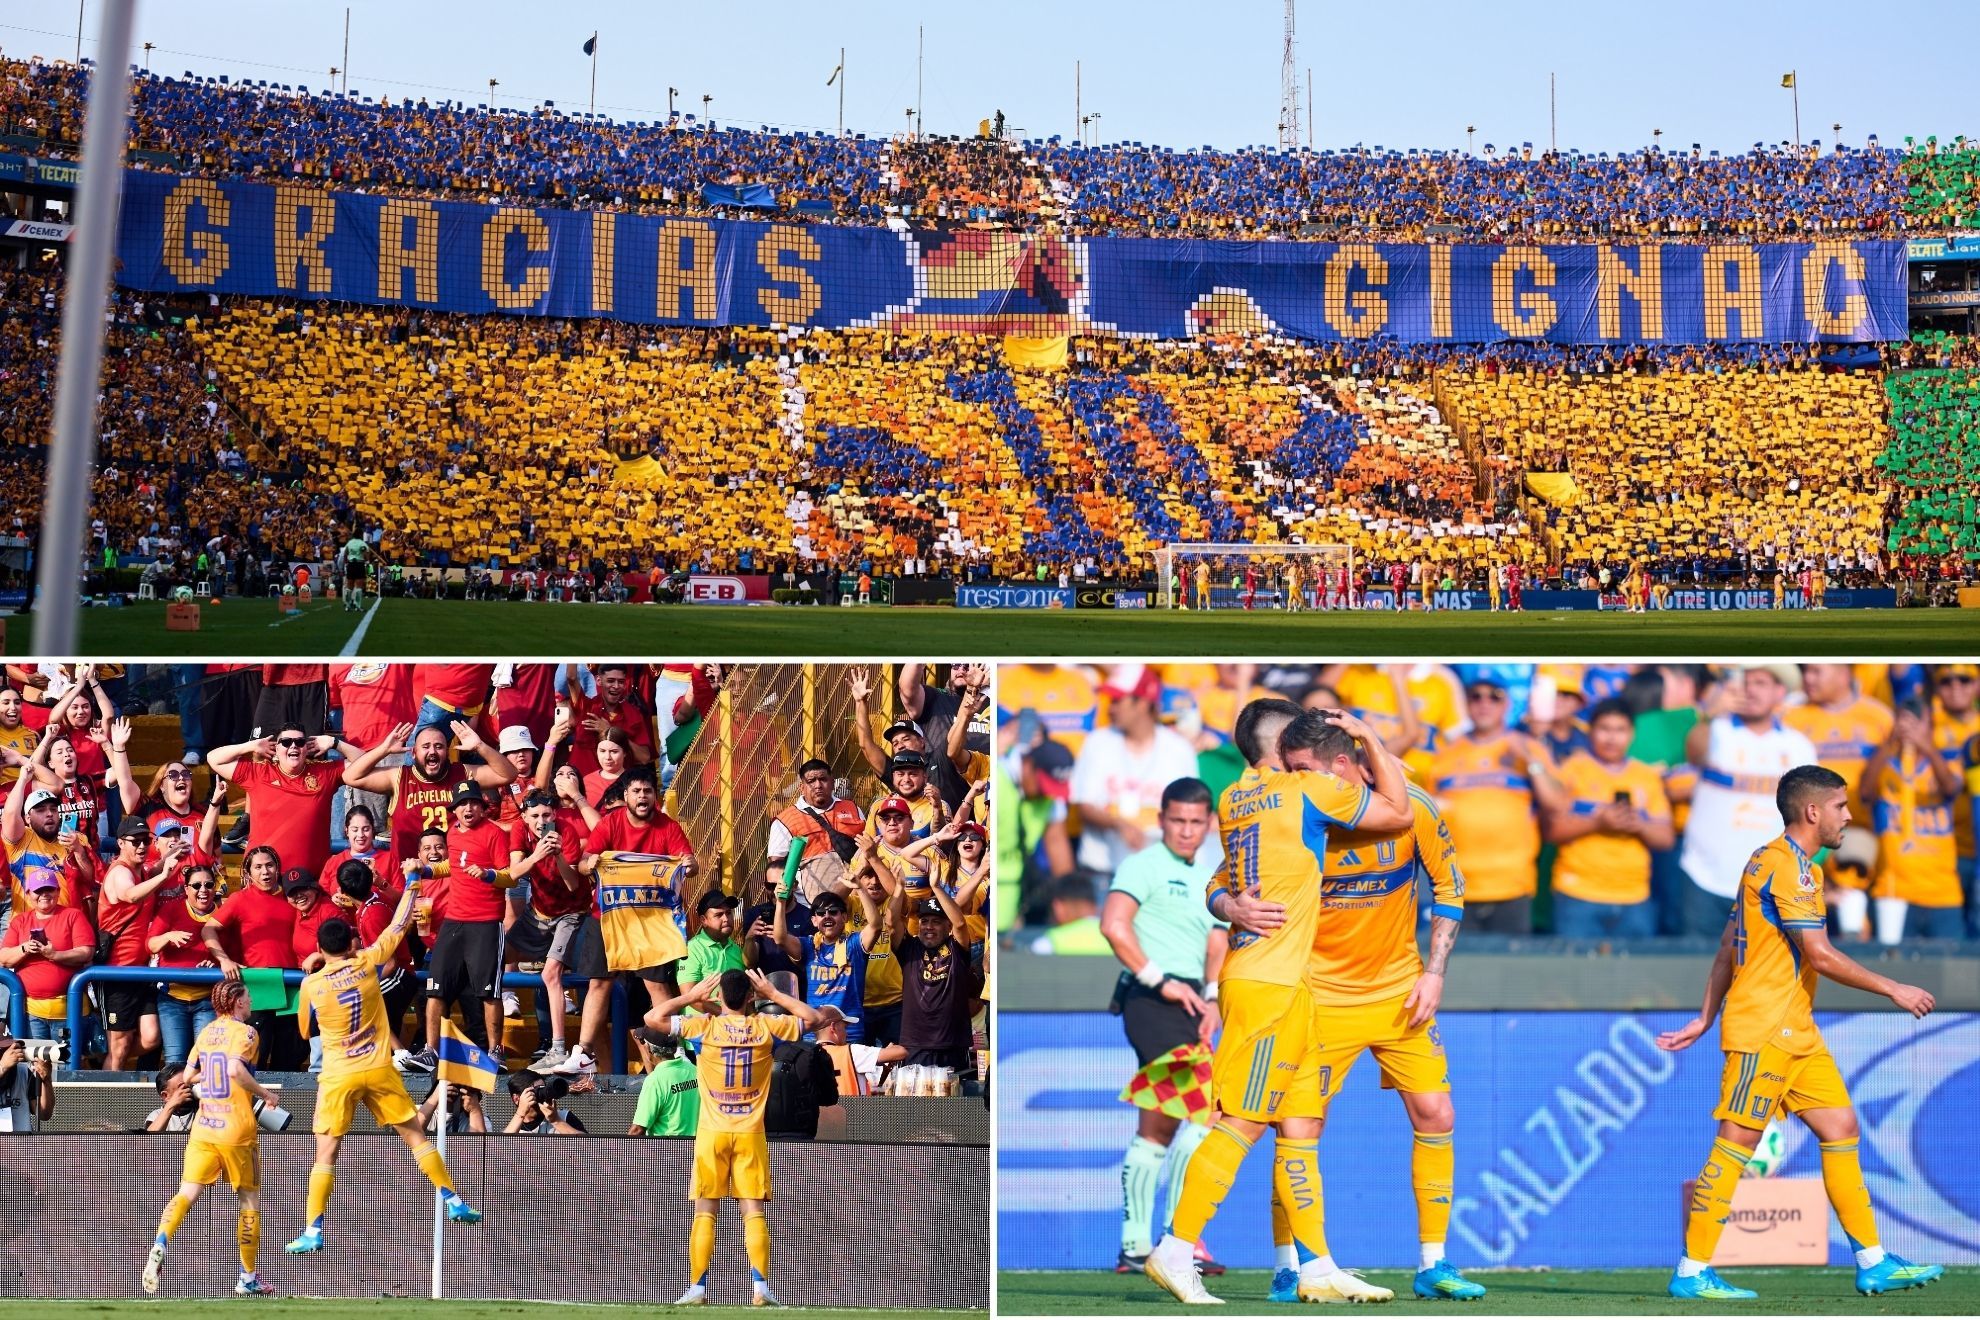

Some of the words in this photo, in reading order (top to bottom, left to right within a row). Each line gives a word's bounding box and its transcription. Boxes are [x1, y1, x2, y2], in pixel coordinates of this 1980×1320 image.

[29, 225, 63, 237] CEMEX
[162, 178, 822, 324] GRACIAS
[1324, 241, 1867, 340] GIGNAC
[1908, 243, 1945, 258] ECATE
[1710, 591, 1731, 609] LO
[1735, 591, 1768, 610] QUE
[406, 789, 454, 810] CLEVELAN
[1230, 792, 1284, 820] AFIRME
[421, 805, 449, 833] 23
[1226, 822, 1260, 899] 11
[1336, 879, 1389, 892] CEMEX
[336, 988, 362, 1035] 7
[200, 1052, 231, 1099] 20
[720, 1046, 754, 1088] 11
[671, 1079, 699, 1095] SEGURID
[1451, 1016, 1675, 1263] CALZADO
[1728, 1208, 1802, 1222] amazon
